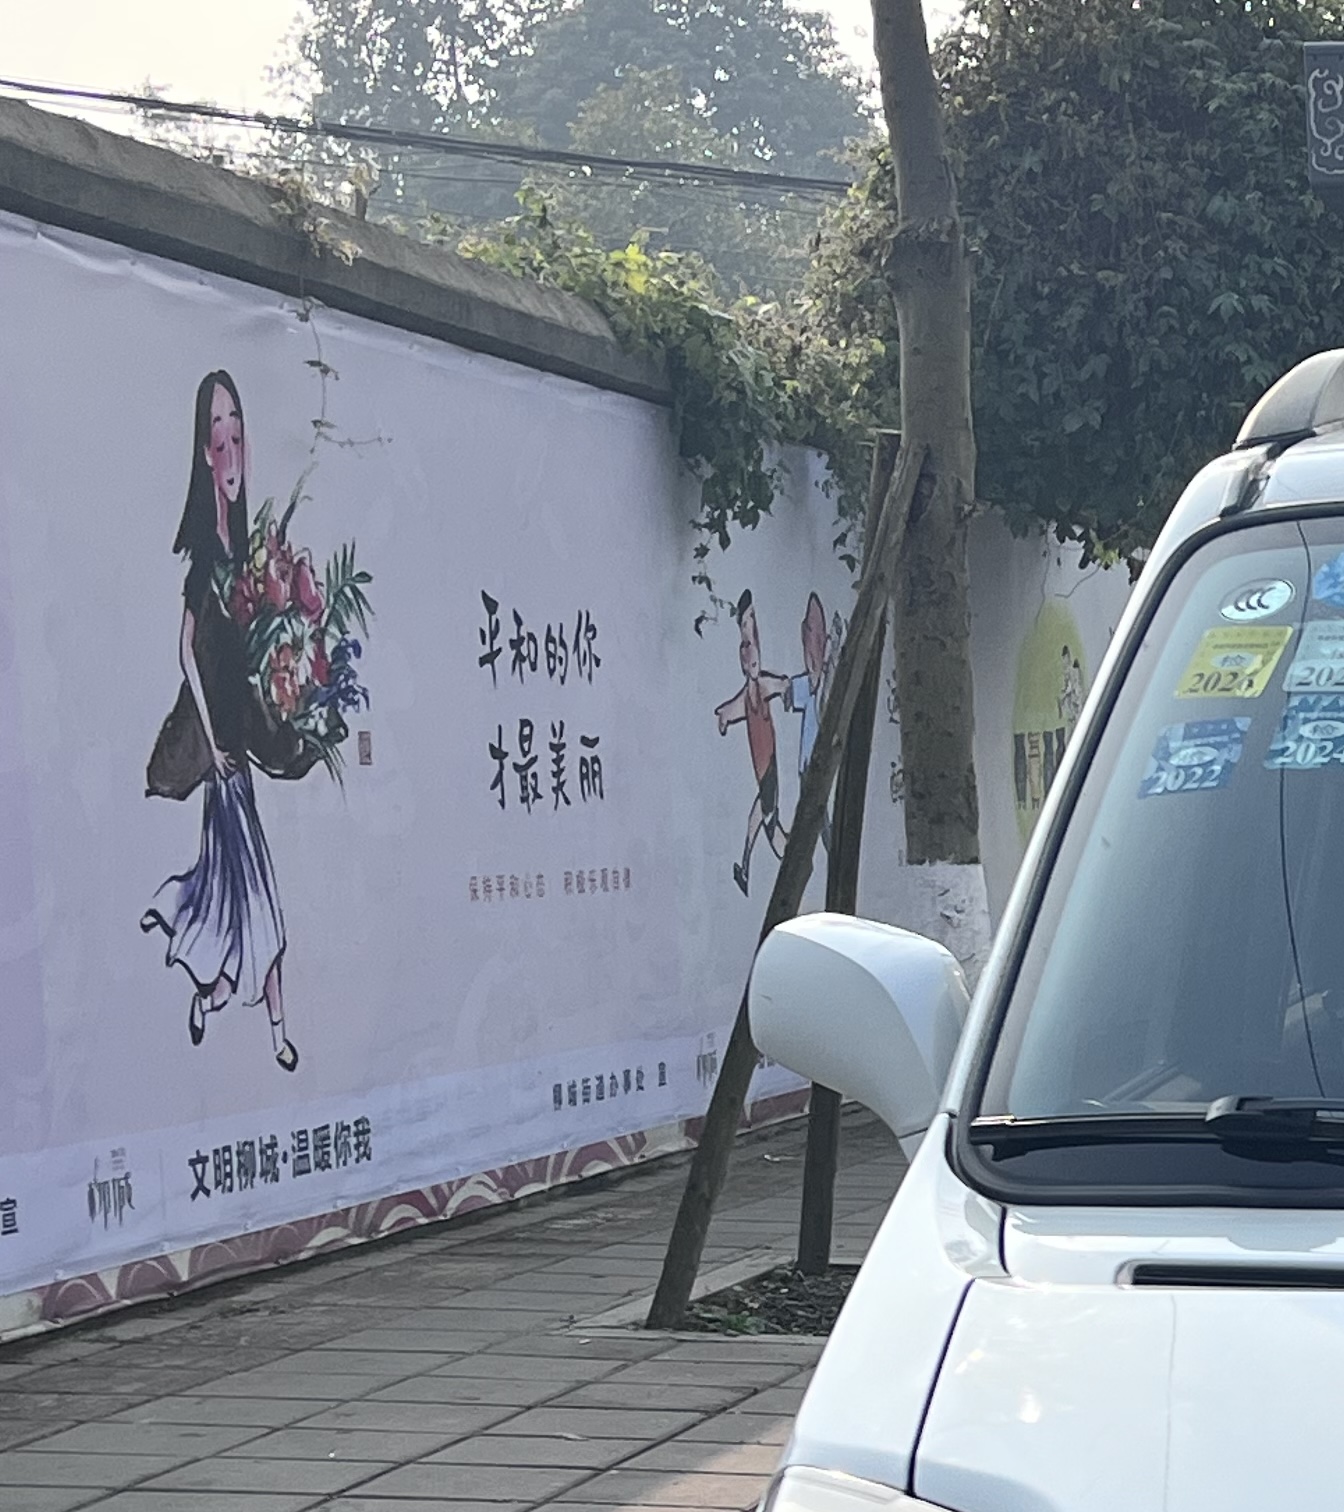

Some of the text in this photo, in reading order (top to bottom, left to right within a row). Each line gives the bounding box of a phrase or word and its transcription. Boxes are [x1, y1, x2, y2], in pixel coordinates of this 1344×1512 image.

[1233, 586, 1276, 612] CCC
[478, 589, 601, 690] 平和的你
[488, 718, 604, 814] 才最美丽
[1147, 765, 1222, 795] 2022
